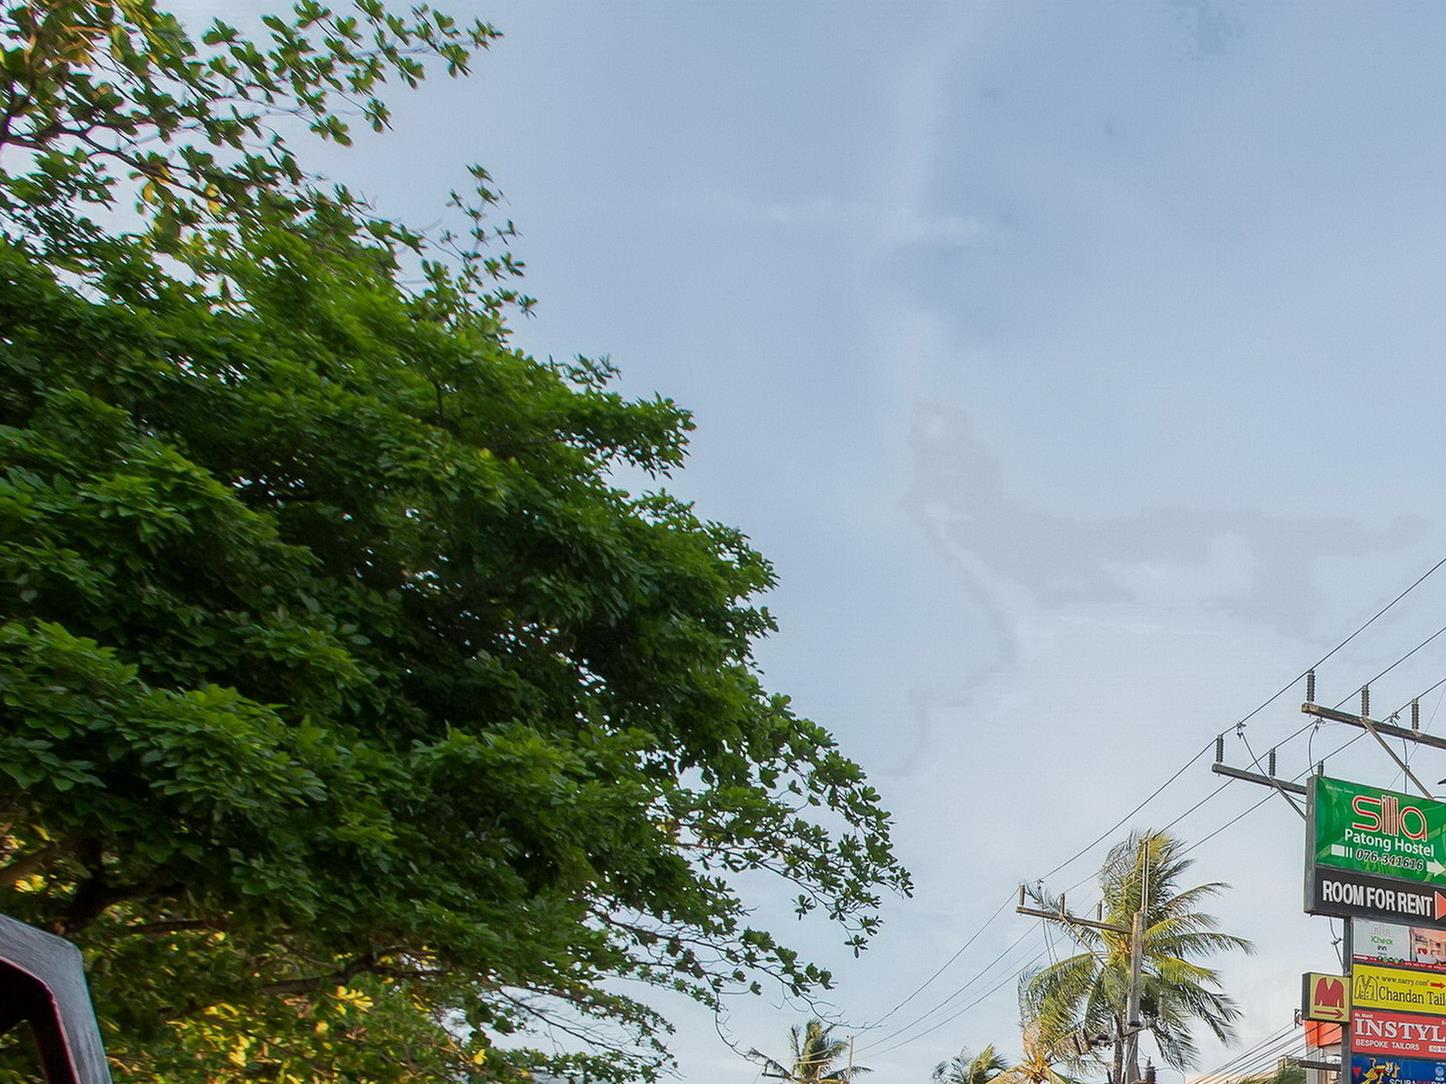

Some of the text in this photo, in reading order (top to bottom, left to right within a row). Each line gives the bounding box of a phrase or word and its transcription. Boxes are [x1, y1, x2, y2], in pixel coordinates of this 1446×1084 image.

[1344, 828, 1434, 858] Patong Hostel
[1355, 848, 1424, 872] 076-341616
[1322, 880, 1433, 917] ROOM FOR RENT
[1378, 986, 1425, 1005] Chandan
[1355, 1038, 1420, 1051] BESPOKE TAILORS
